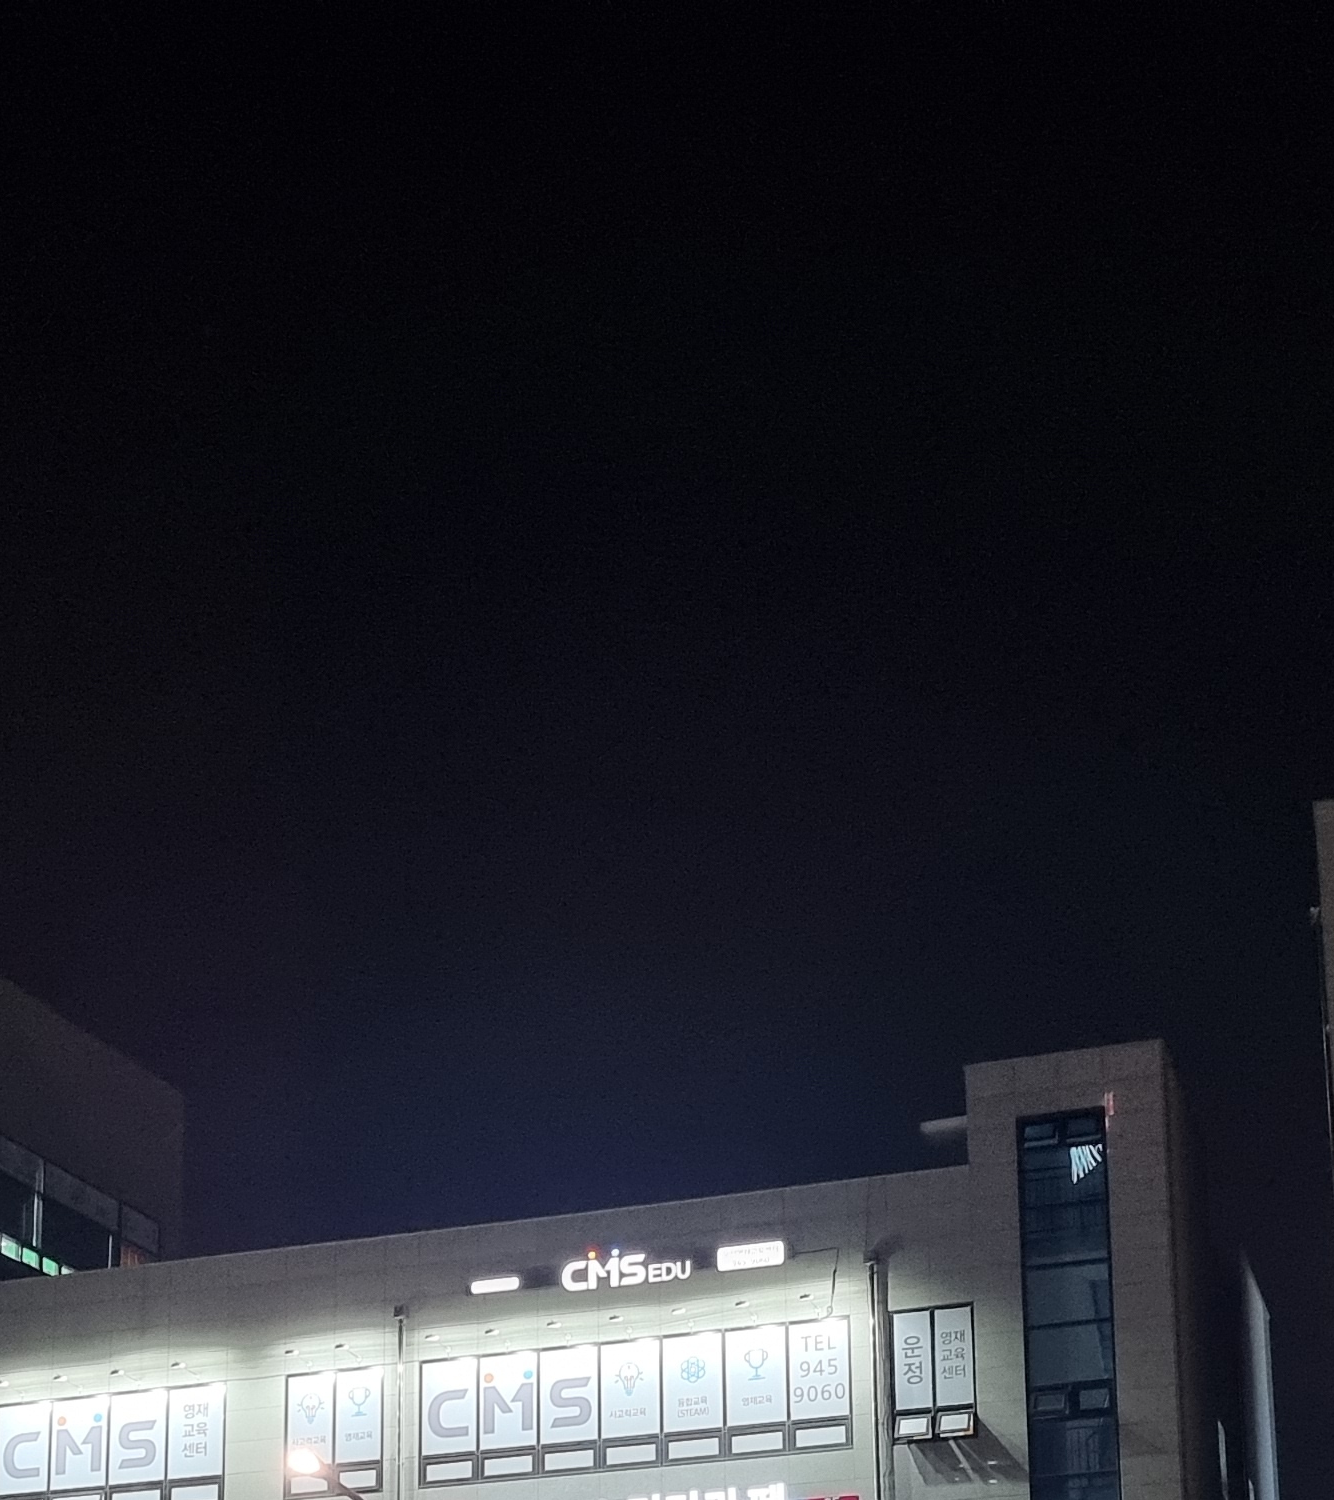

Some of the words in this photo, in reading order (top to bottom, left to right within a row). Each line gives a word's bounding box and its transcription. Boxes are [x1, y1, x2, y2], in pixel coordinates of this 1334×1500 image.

[647, 1260, 691, 1284] EDU
[801, 1334, 837, 1353] TEL
[940, 1329, 966, 1345] 영재
[901, 1335, 924, 1385] 운정
[940, 1347, 966, 1362] 교육
[799, 1358, 838, 1378] 945
[941, 1364, 966, 1380] 센터
[794, 1382, 846, 1404] 9060
[182, 1403, 209, 1418] 영재
[427, 1370, 592, 1438] CMS
[182, 1422, 208, 1438] 교육
[3, 1413, 156, 1479] CMS
[181, 1442, 208, 1458] 센터
